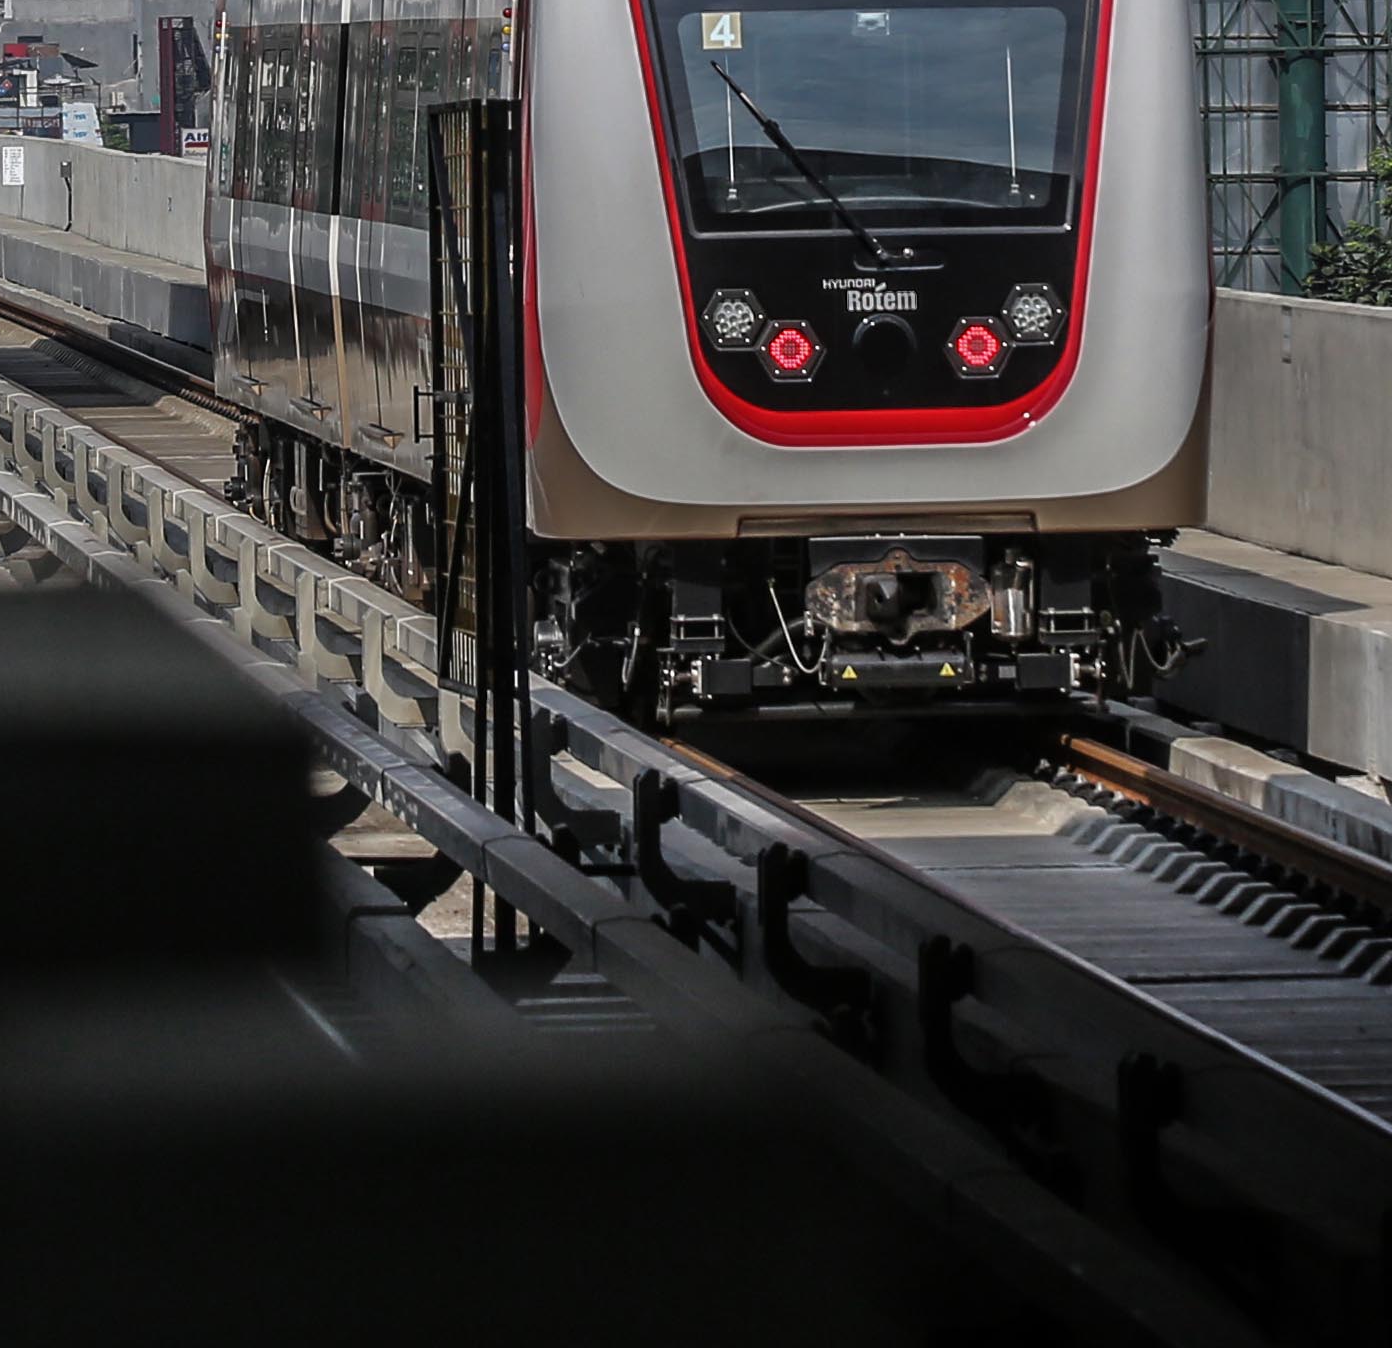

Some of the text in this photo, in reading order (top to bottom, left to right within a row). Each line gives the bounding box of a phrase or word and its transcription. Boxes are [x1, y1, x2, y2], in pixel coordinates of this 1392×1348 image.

[710, 15, 735, 47] 4
[821, 277, 877, 290] HYUNDAI
[846, 282, 918, 312] Rotem
